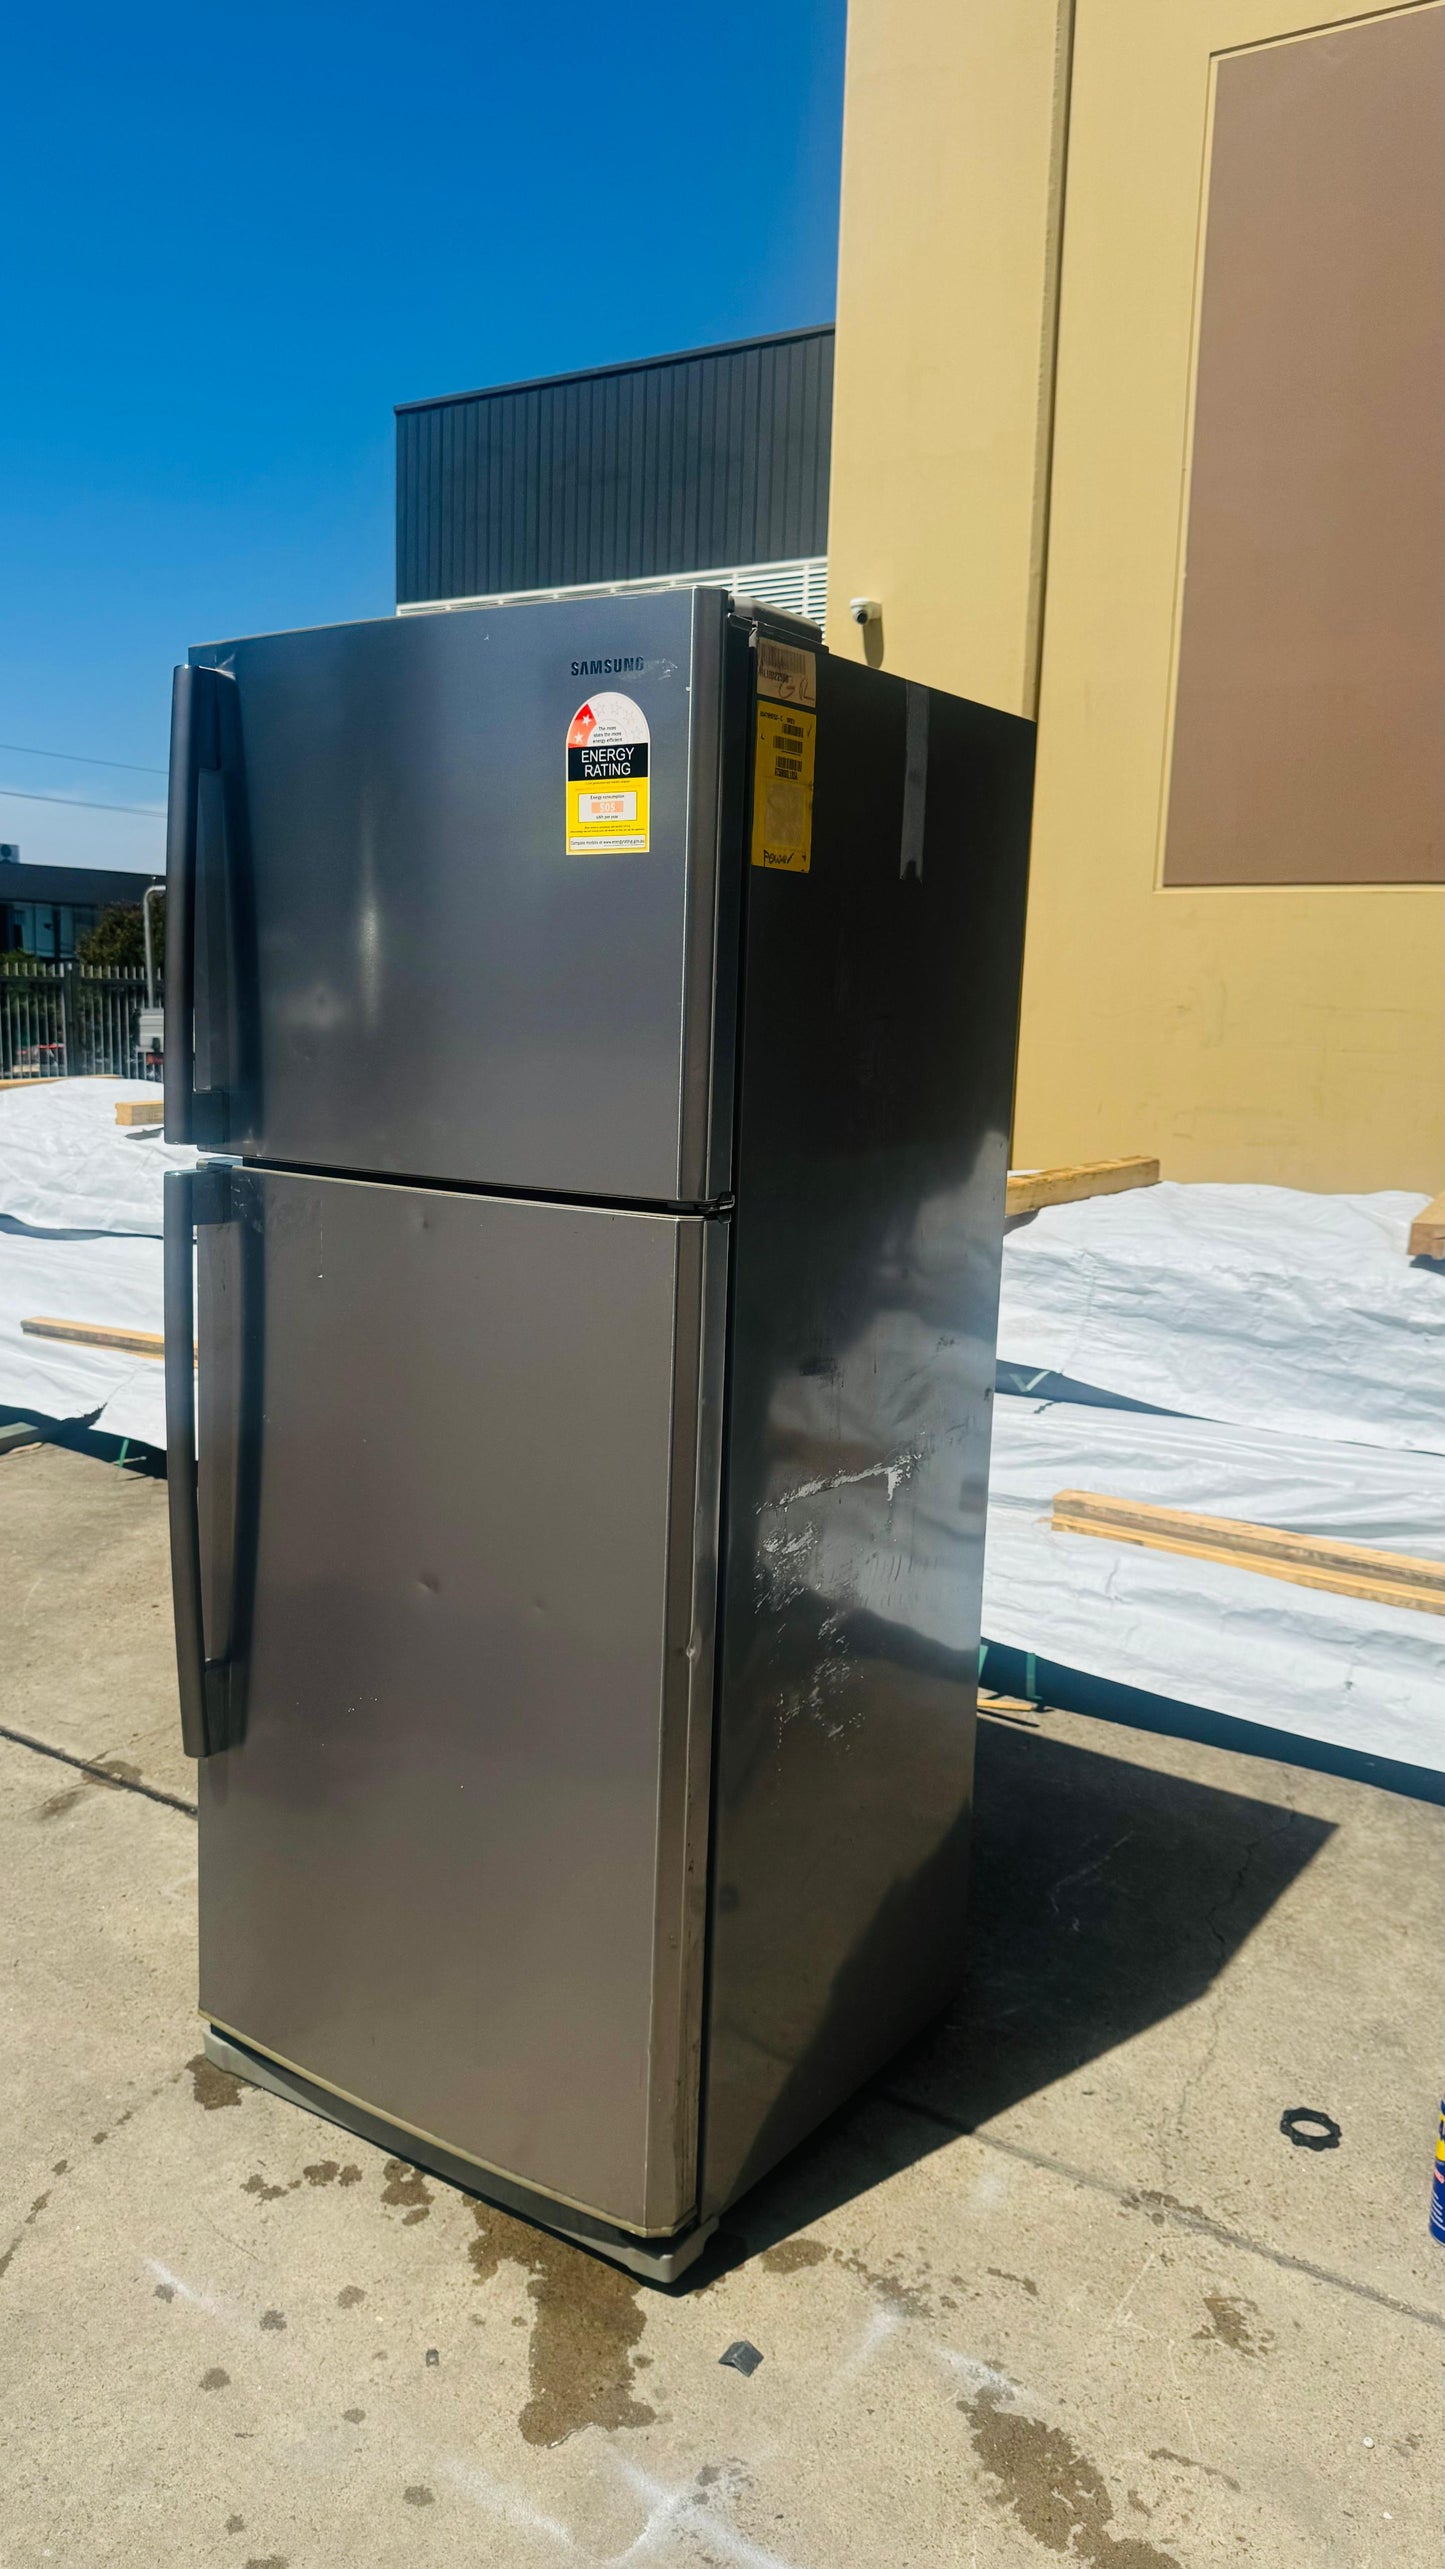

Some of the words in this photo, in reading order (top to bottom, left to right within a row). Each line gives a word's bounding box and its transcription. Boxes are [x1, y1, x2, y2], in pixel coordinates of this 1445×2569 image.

[571, 656, 644, 676] SAMSUNG
[581, 747, 634, 763] ENERGY
[584, 762, 631, 777] RATING
